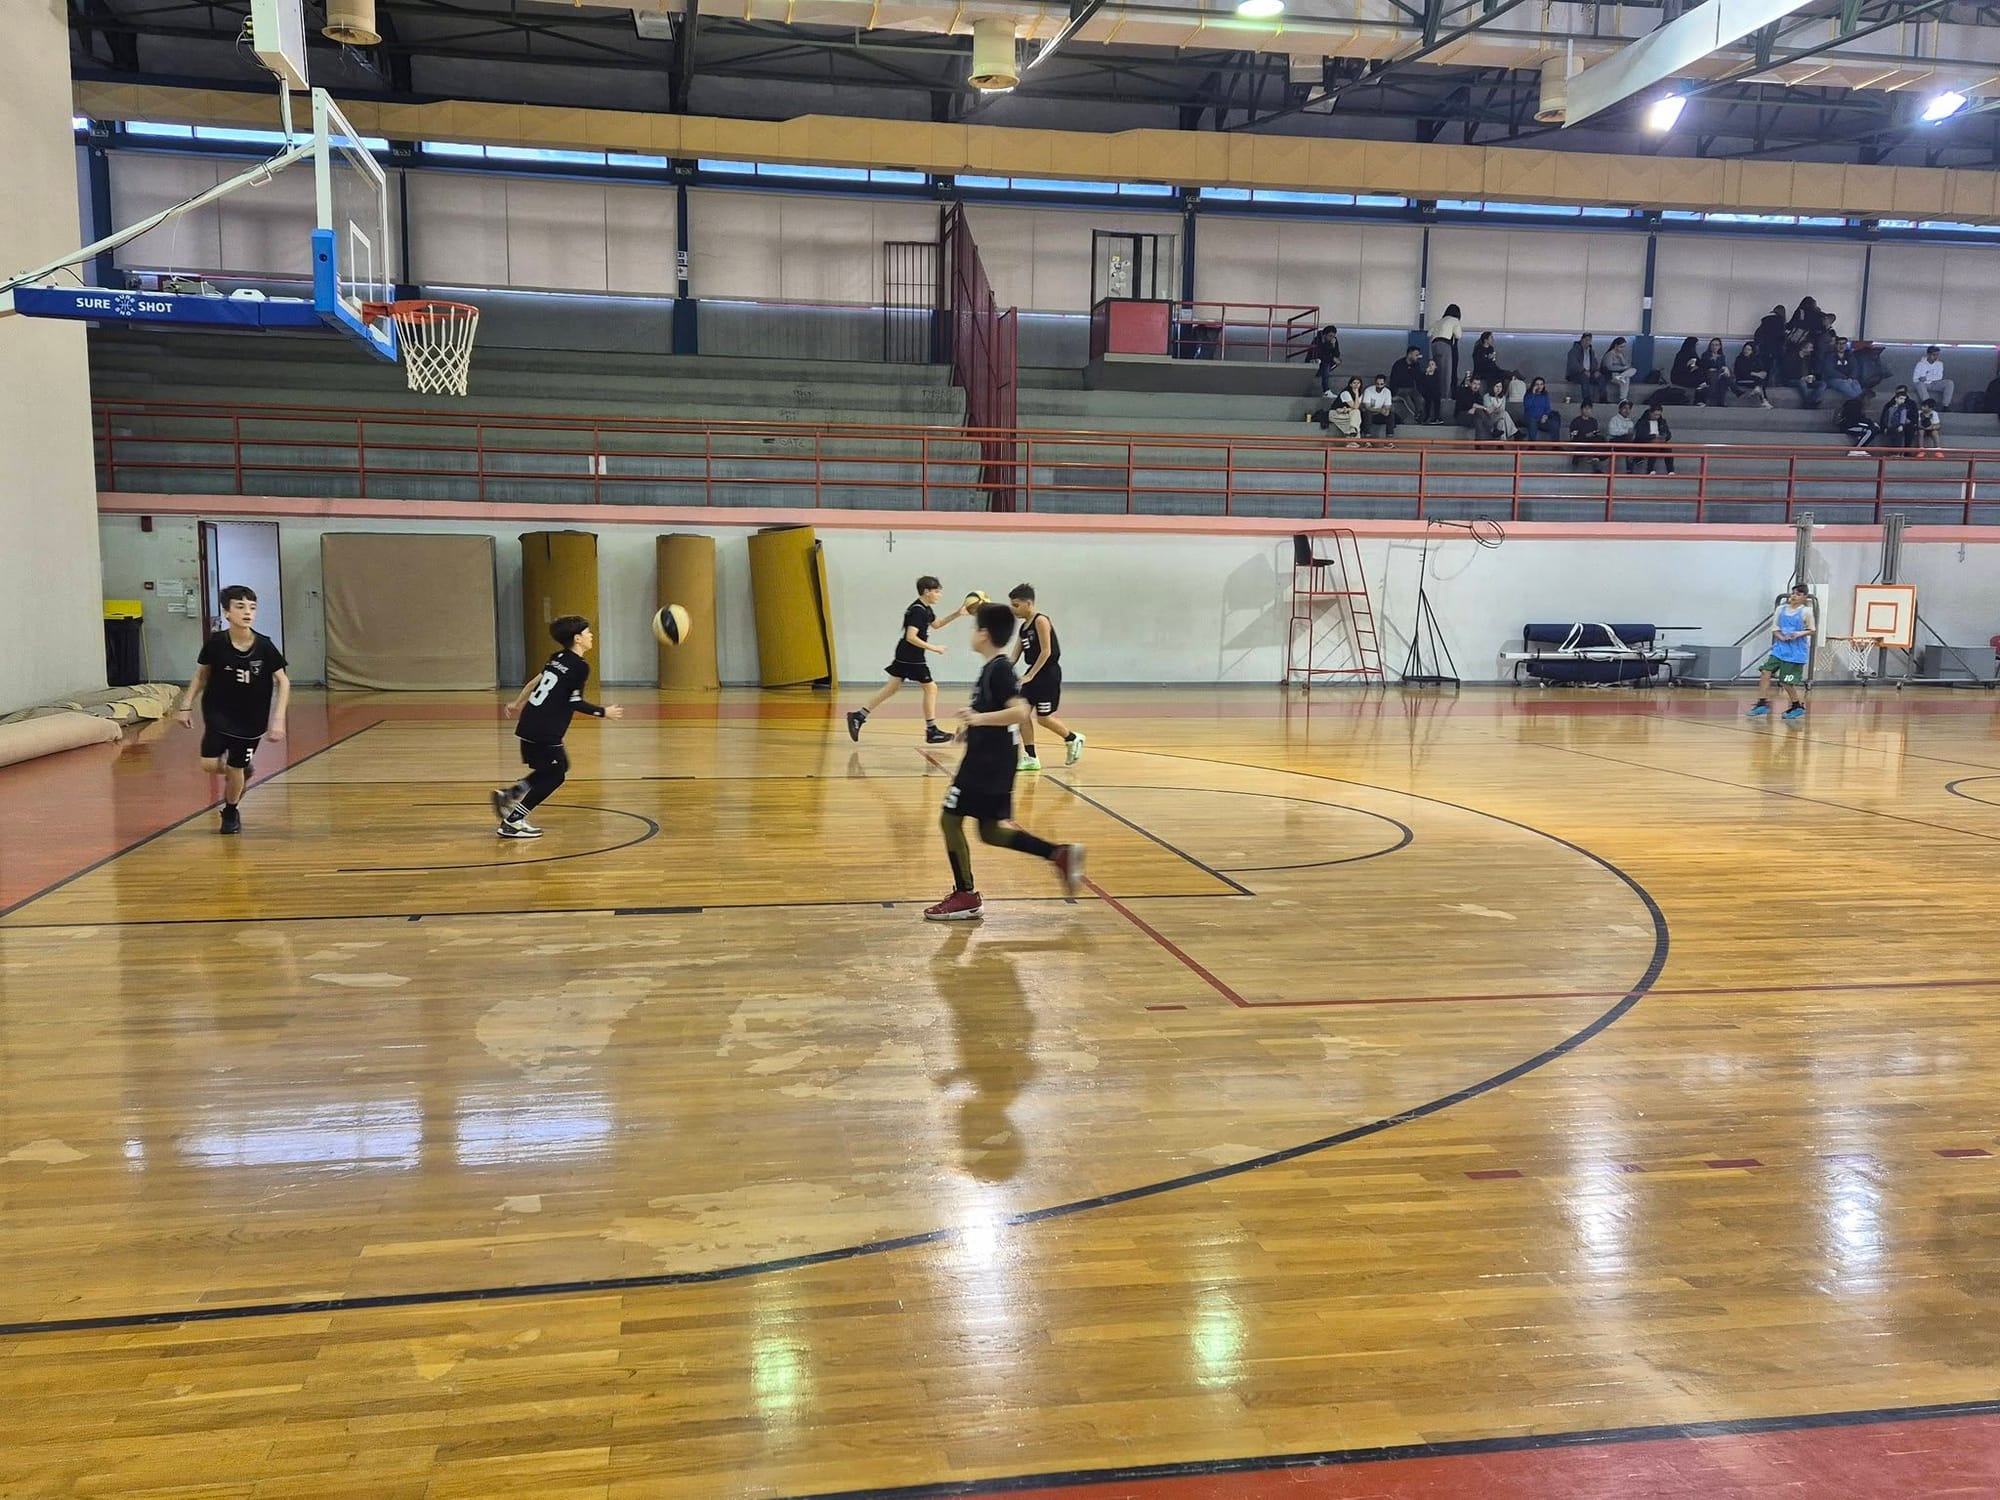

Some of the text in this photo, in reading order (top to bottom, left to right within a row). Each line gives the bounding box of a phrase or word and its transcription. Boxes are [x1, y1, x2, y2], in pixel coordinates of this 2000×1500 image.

[76, 297, 173, 313] SURE SHOT
[236, 668, 250, 684] 31
[1784, 674, 1794, 682] 10
